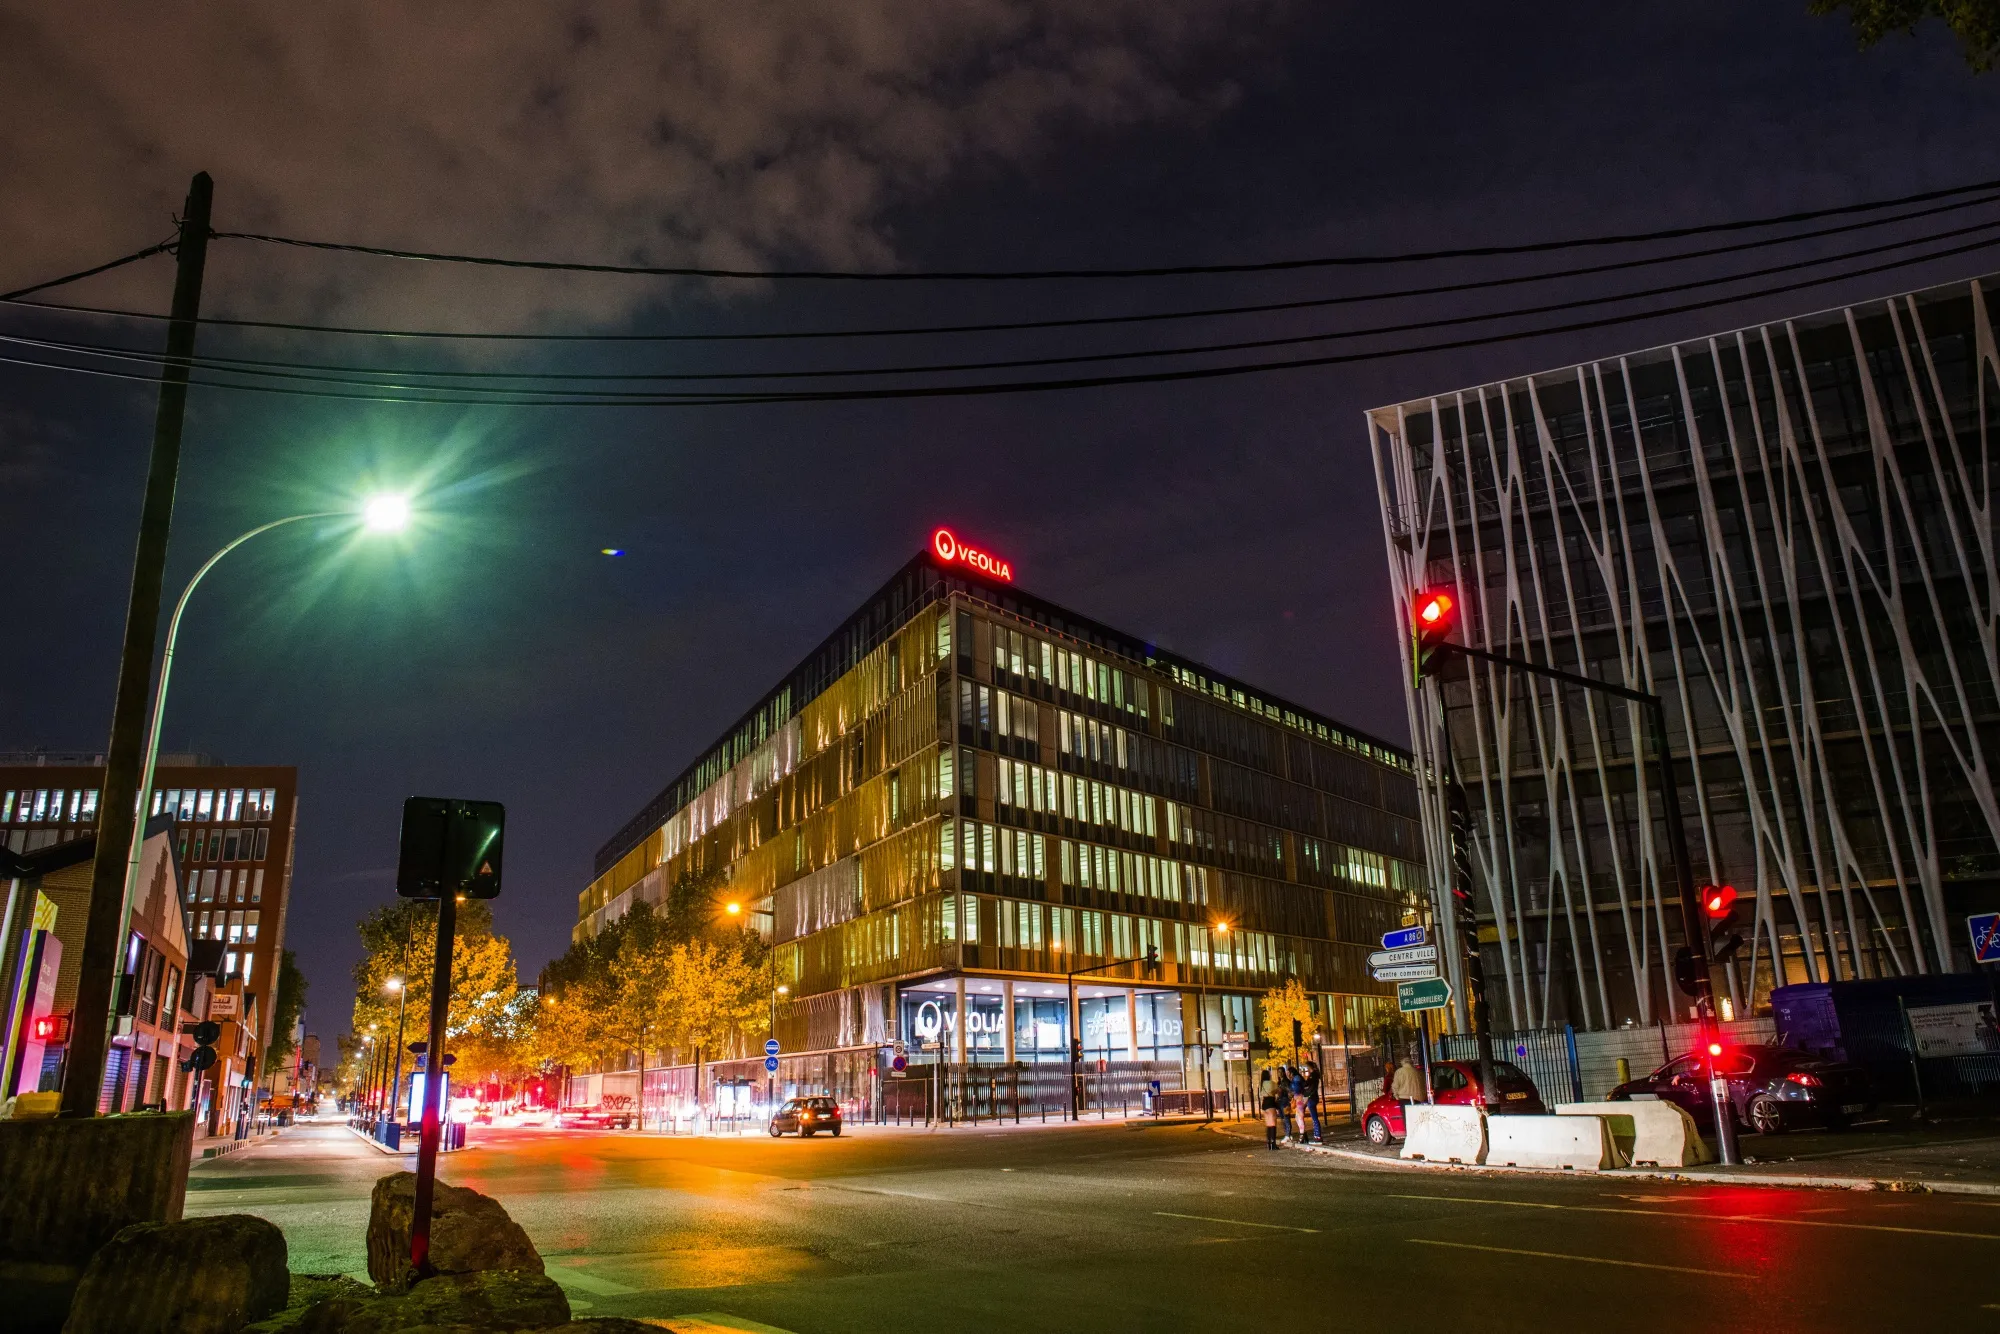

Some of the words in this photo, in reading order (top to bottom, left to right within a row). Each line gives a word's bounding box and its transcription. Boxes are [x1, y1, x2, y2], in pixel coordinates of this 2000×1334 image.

[958, 544, 1011, 580] VEOLIA
[1404, 933, 1408, 943] A
[1389, 951, 1413, 961] CENTRE
[1417, 949, 1434, 957] VILLE
[1400, 968, 1434, 977] commercial
[1400, 987, 1414, 997] PARIS
[944, 1011, 1004, 1034] VOLIA
